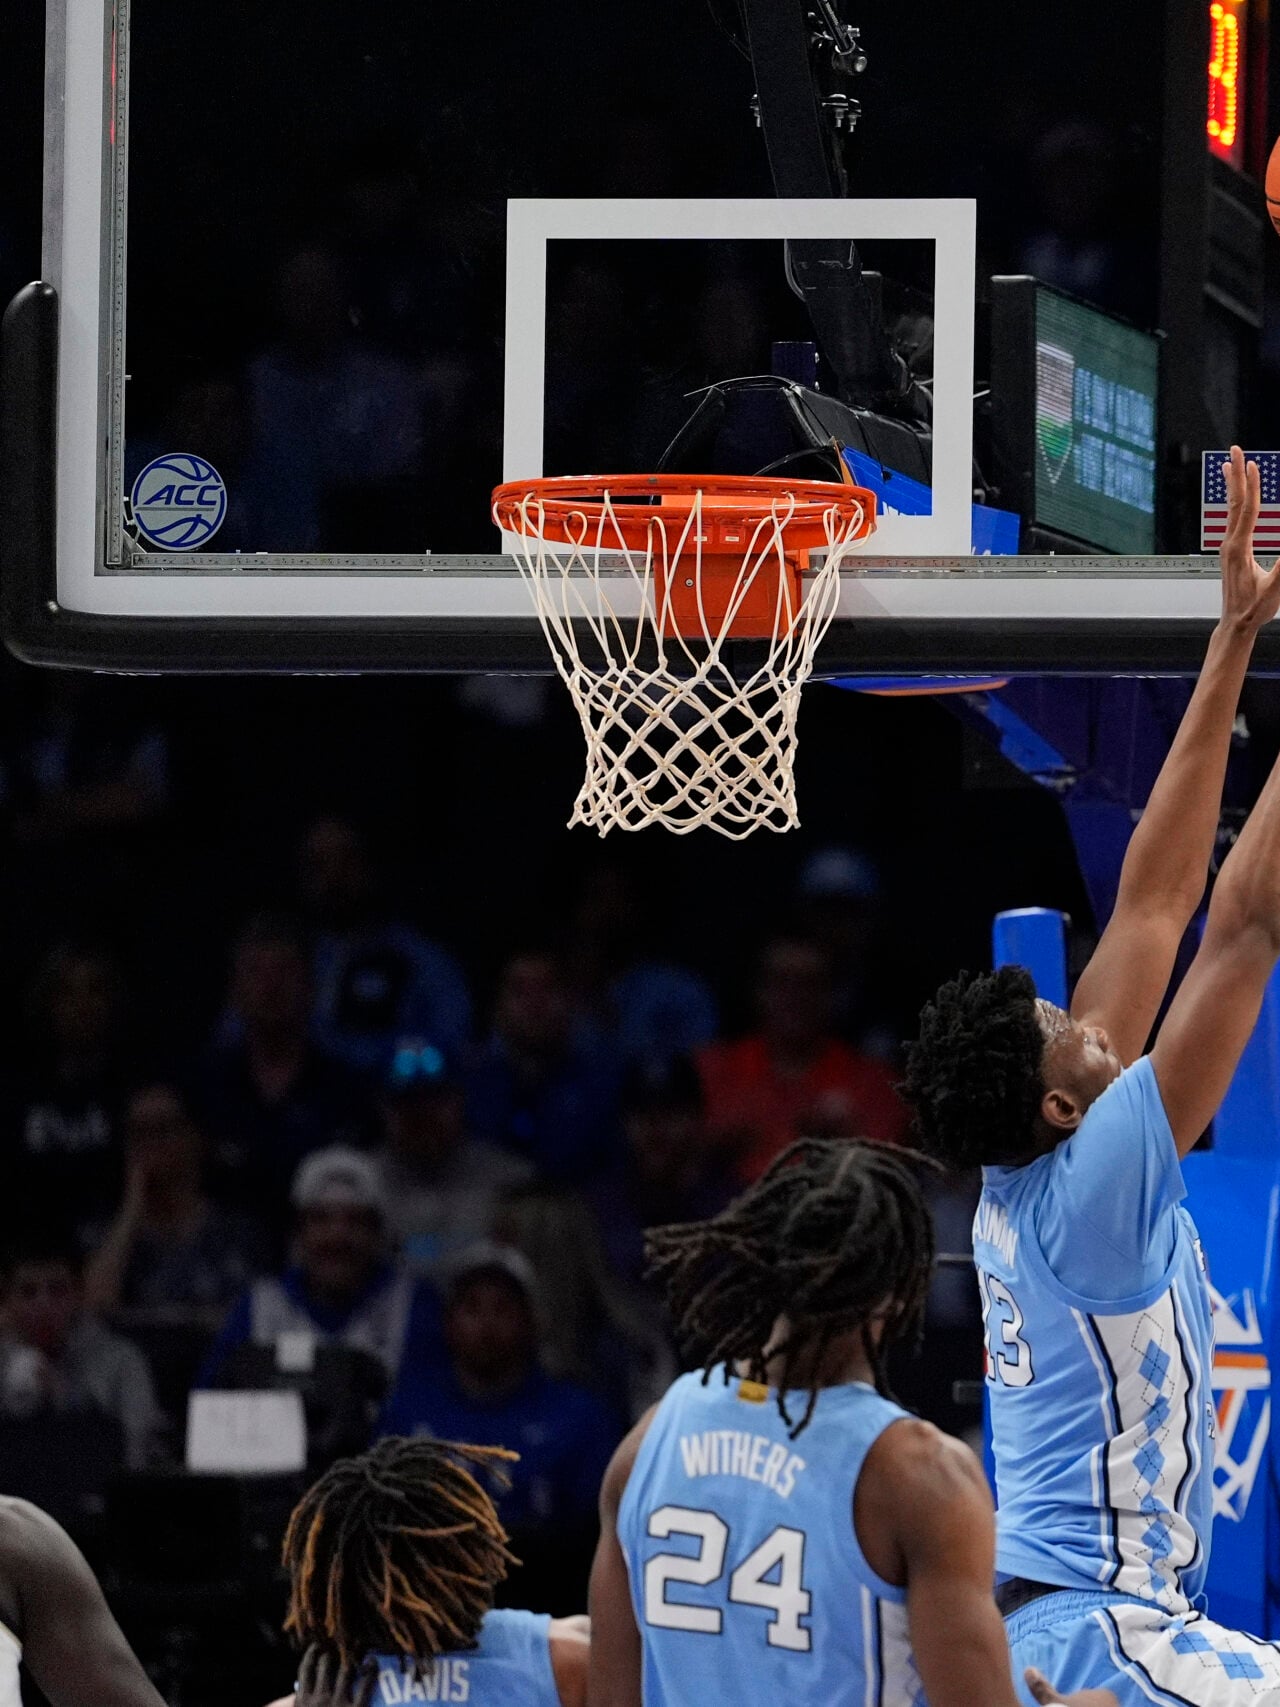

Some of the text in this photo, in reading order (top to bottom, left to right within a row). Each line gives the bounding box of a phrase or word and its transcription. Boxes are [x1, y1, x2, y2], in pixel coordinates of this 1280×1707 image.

[142, 484, 222, 505] ACC
[978, 1266, 1036, 1387] 13
[680, 1430, 806, 1500] WITHERS
[645, 1504, 812, 1653] 24
[378, 1657, 470, 1705] DAVIS
